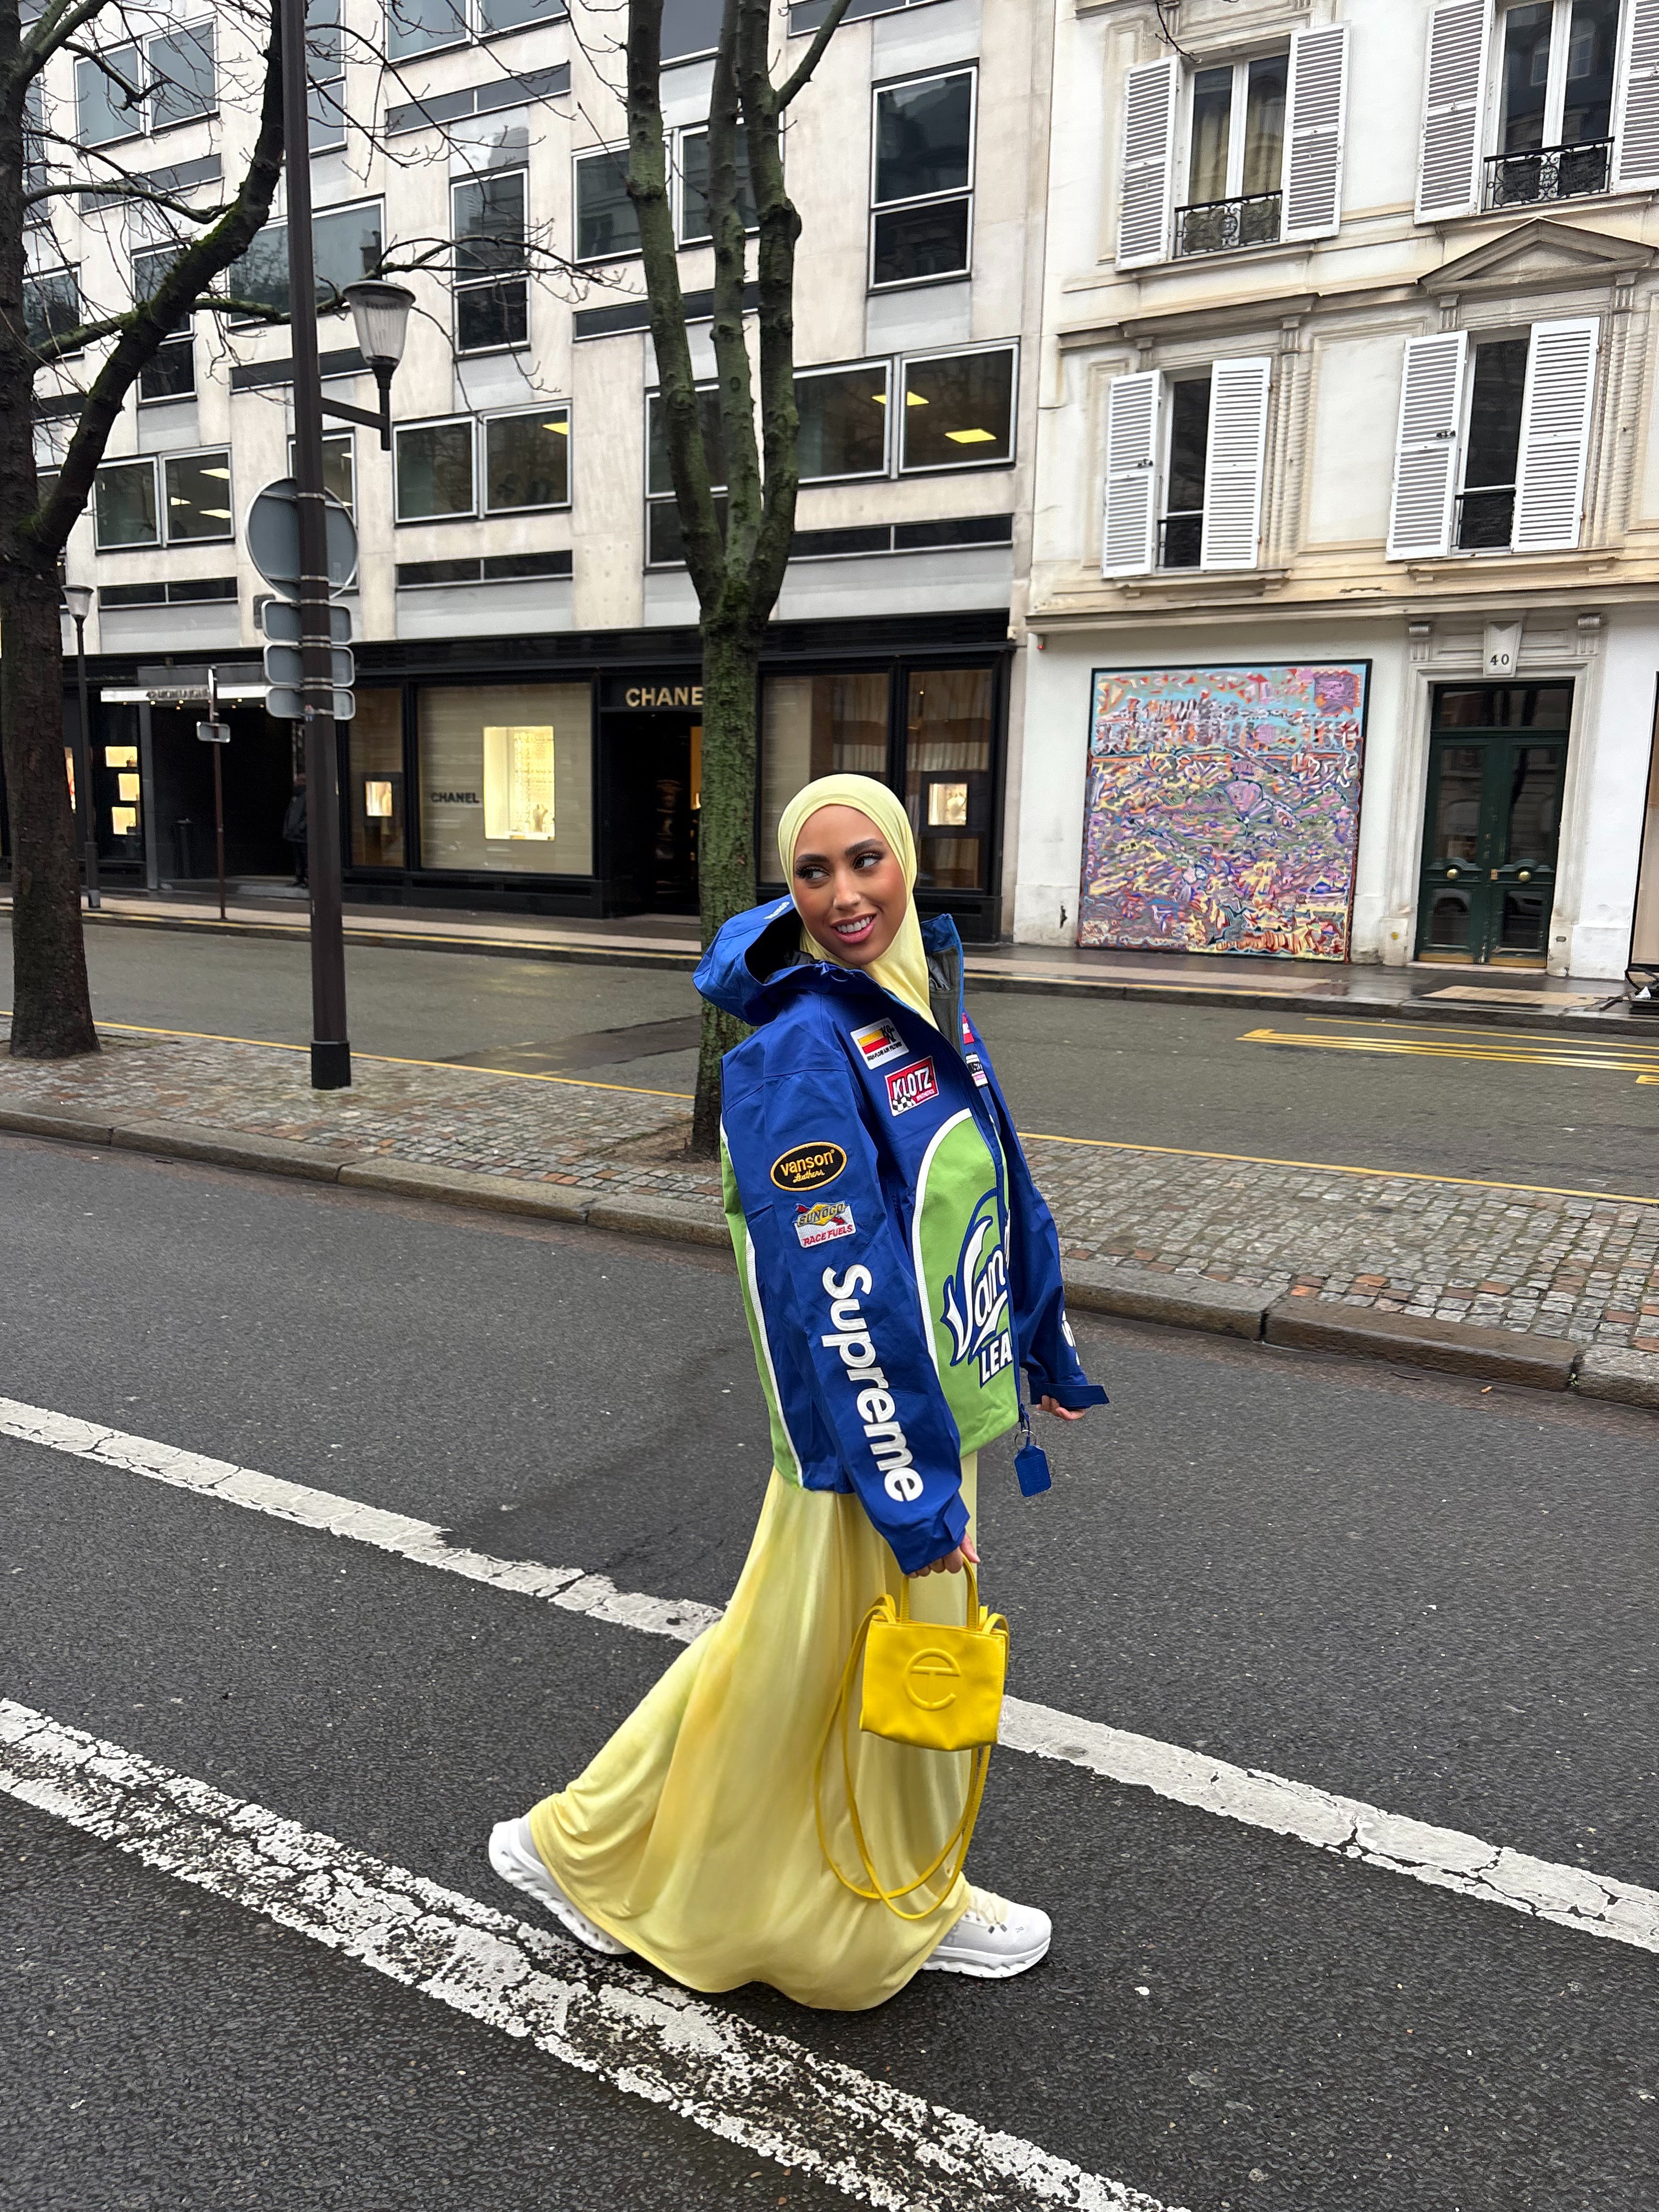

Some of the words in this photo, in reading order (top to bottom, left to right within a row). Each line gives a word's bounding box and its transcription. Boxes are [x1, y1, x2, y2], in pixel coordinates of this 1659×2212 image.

[1490, 654, 1509, 665] 40
[625, 687, 703, 707] CHANE
[431, 792, 479, 803] CHANEL
[892, 1066, 932, 1101] KLOTZ
[780, 1152, 833, 1176] vanson
[793, 1169, 825, 1183] Leathers
[798, 1203, 845, 1227] SUNOCO
[803, 1232, 827, 1246] RACE
[827, 1224, 853, 1239] FUELS
[982, 1331, 1013, 1384] LEA
[821, 1264, 924, 1502] Supreme
